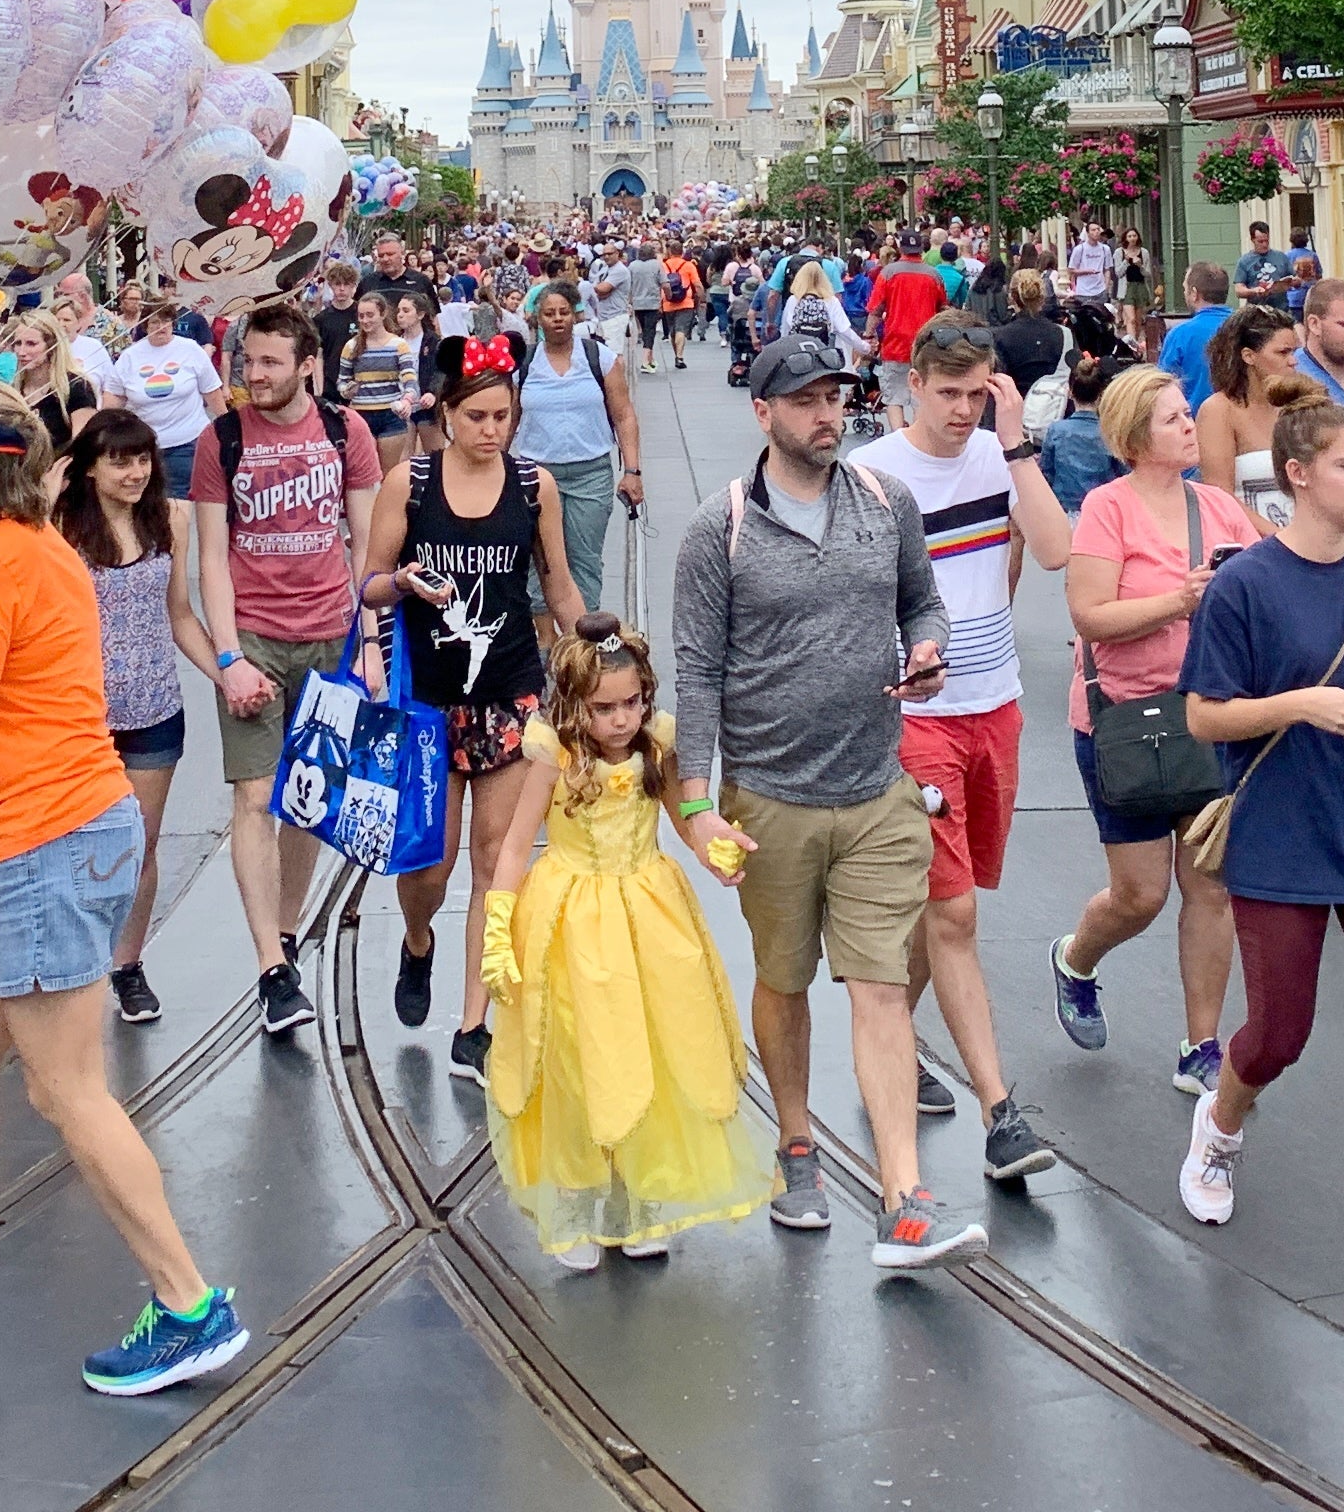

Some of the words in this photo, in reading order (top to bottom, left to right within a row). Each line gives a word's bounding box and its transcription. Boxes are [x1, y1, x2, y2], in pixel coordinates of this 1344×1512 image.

[943, 7, 956, 57] CRYSTAL
[232, 459, 343, 524] SUPERDRY
[257, 534, 323, 544] GENERAL
[416, 542, 519, 574] DRINKERBELL
